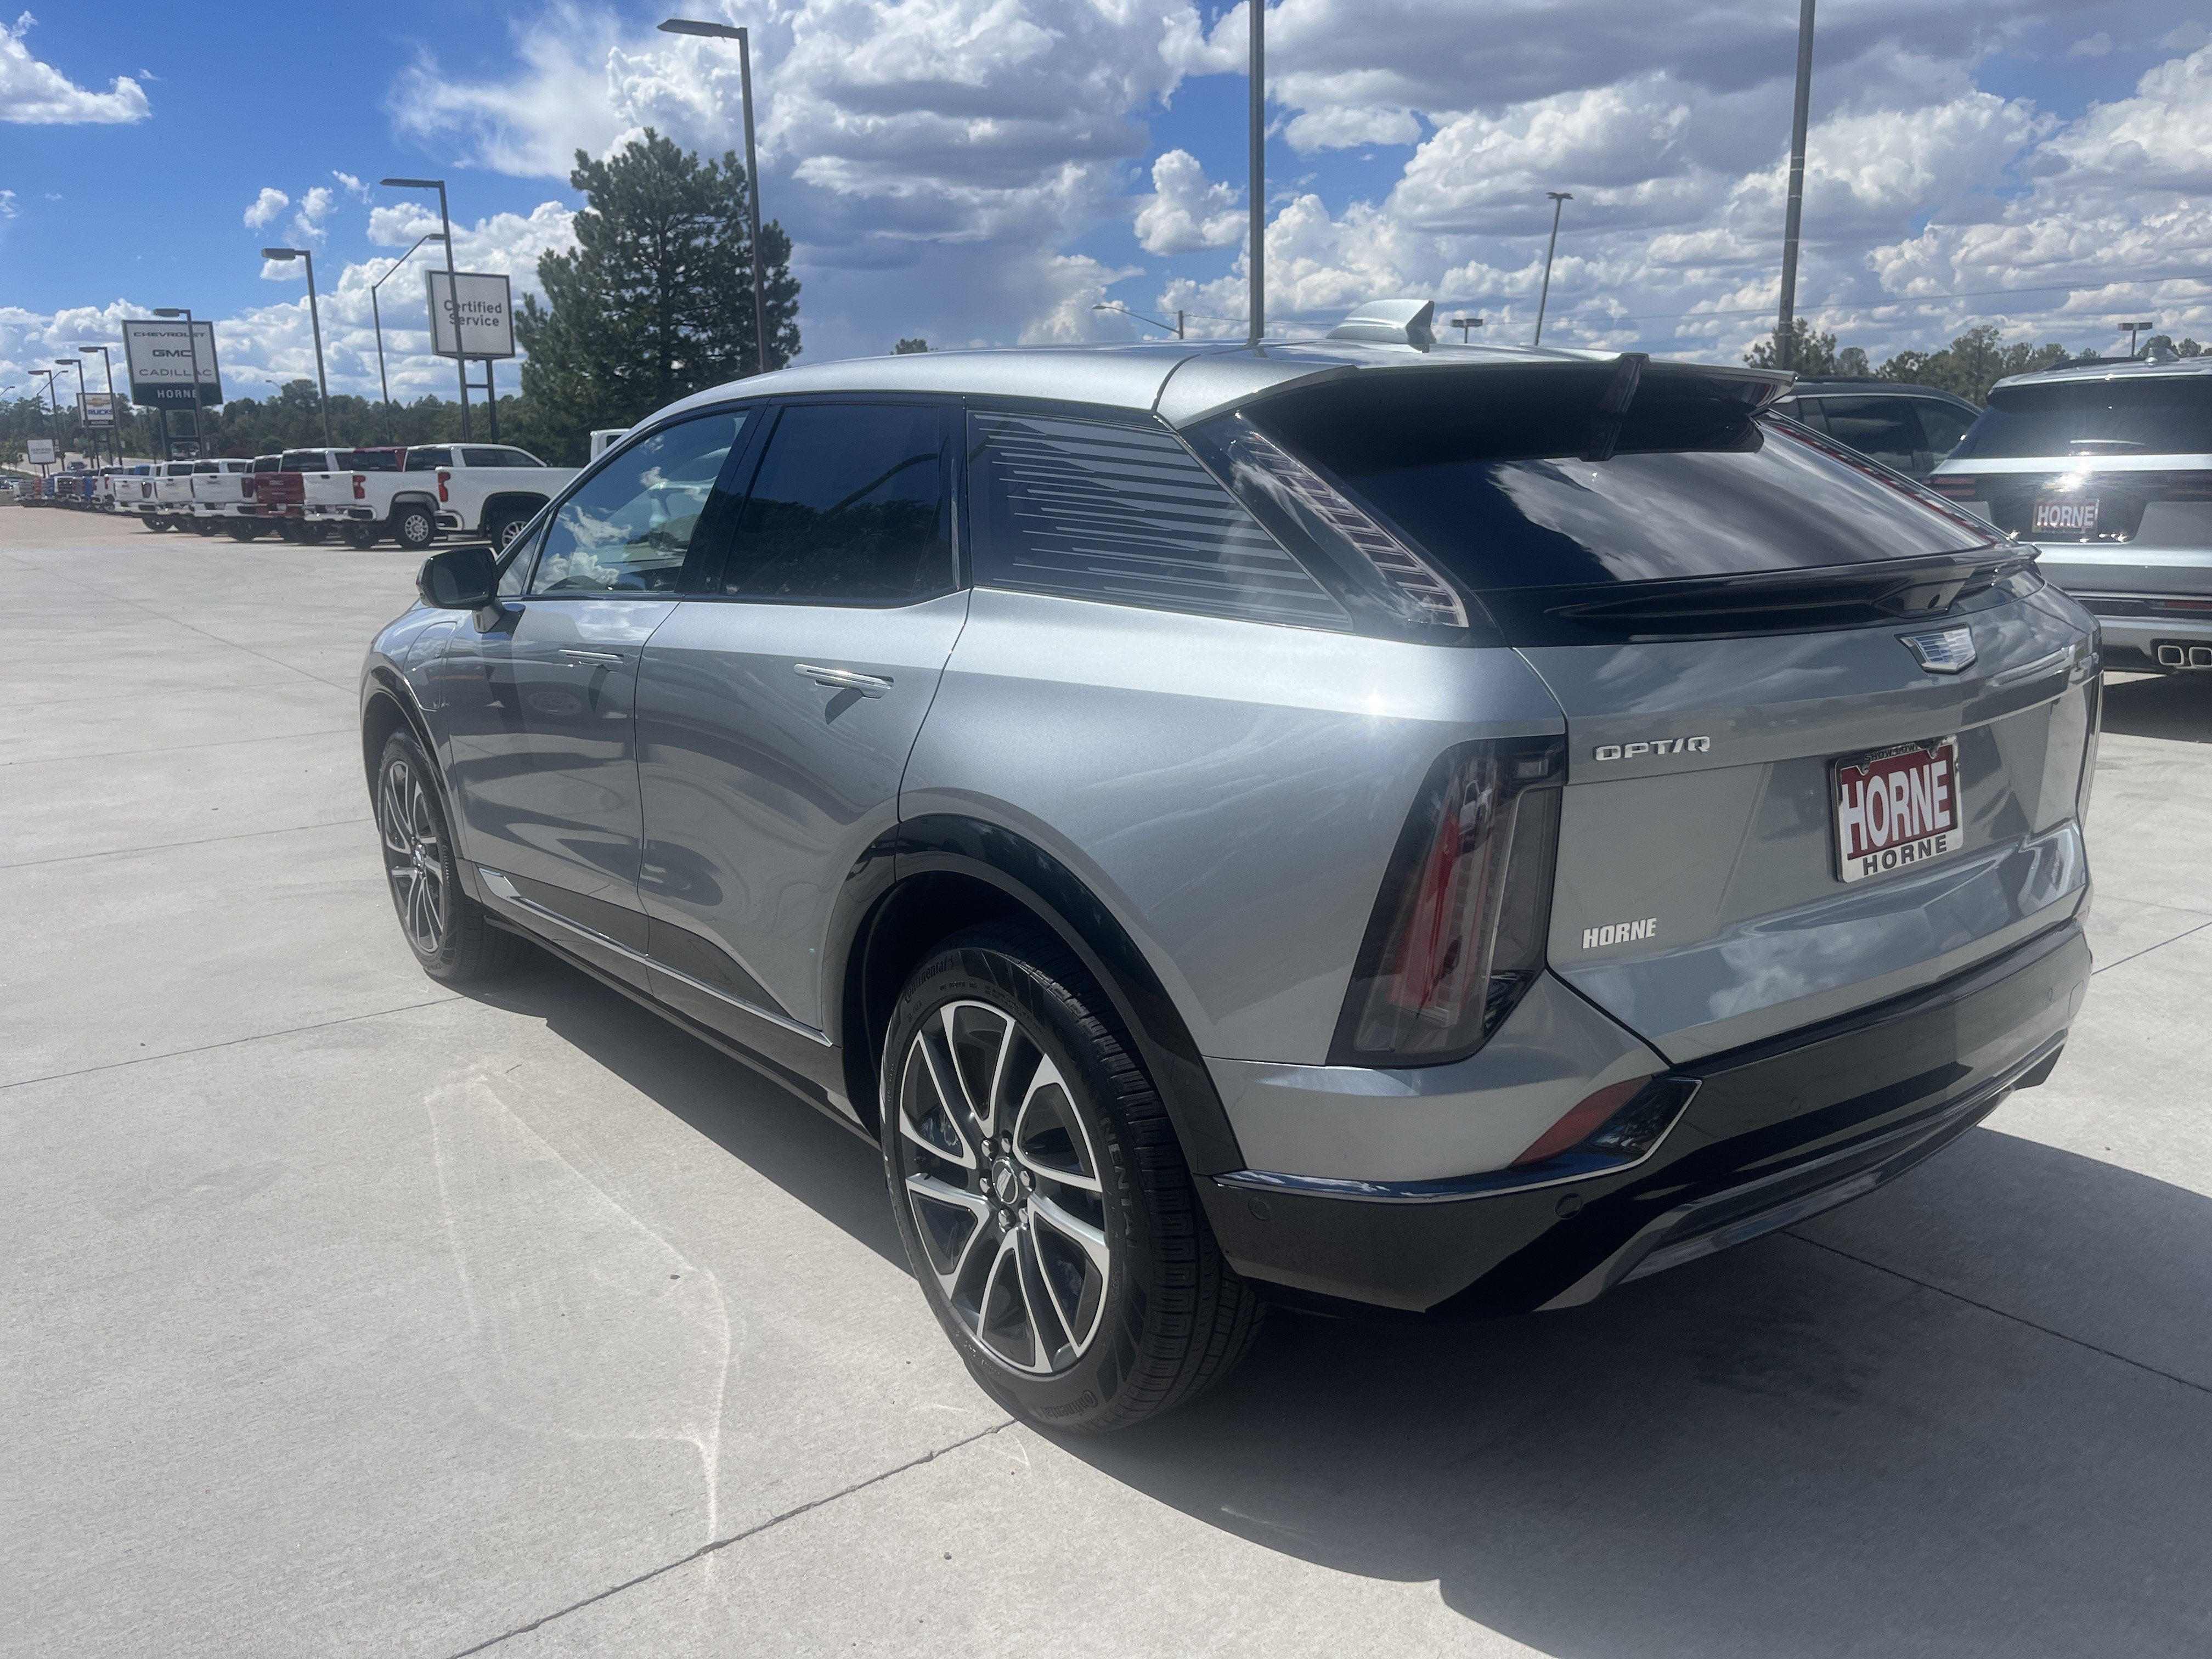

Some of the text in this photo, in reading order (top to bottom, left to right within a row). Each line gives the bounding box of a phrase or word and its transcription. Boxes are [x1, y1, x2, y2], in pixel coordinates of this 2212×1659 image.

[444, 300, 501, 313] Crtified
[449, 313, 499, 326] Service
[157, 390, 198, 398] HORNE
[2037, 505, 2095, 526] HORNE
[1842, 760, 1950, 854] HORNE
[1863, 834, 1947, 876] HORNE
[1582, 917, 1657, 949] HORNE
